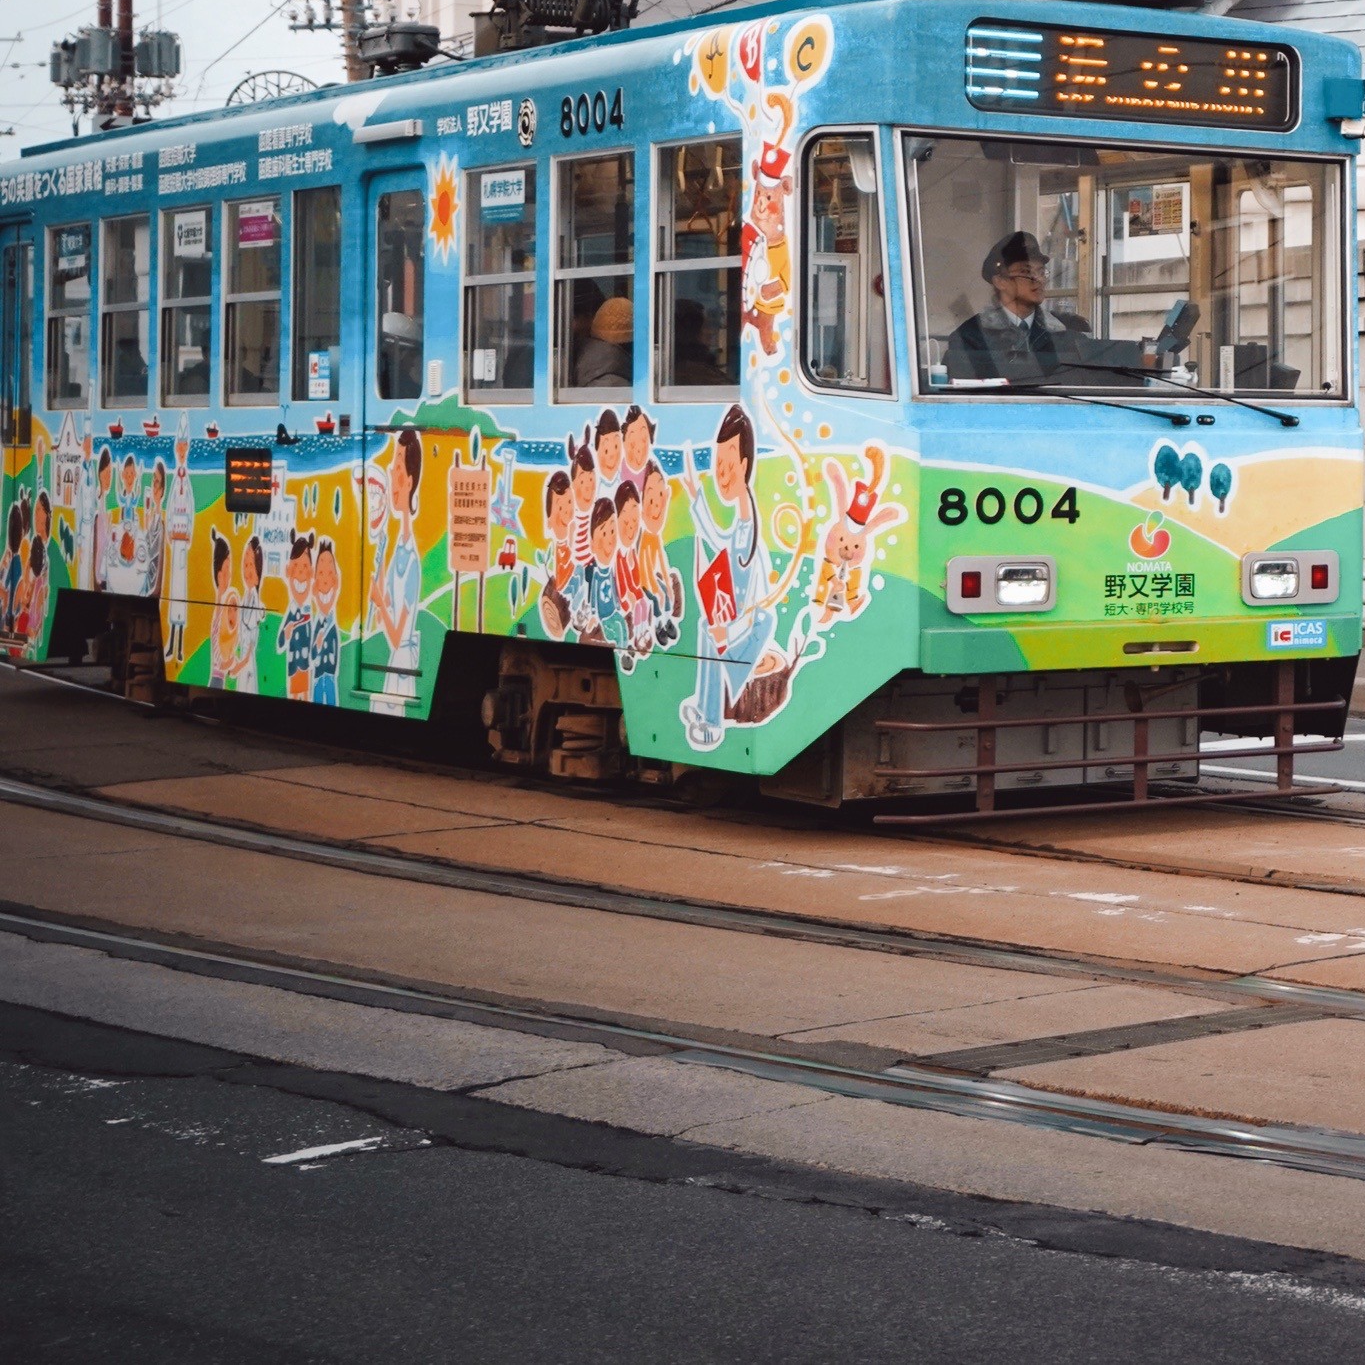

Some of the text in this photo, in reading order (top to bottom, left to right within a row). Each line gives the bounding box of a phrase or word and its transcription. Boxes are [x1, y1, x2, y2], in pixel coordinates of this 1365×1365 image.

[746, 23, 759, 69] B
[796, 36, 815, 72] C
[467, 99, 512, 136] 野又学園
[561, 87, 625, 138] 8004
[938, 487, 1080, 526] 8004
[1126, 561, 1173, 573] NOMATA
[1104, 574, 1196, 599] 野又学園
[1104, 601, 1195, 616] 短大・専門学校号
[1294, 622, 1323, 635] ICAS
[1294, 636, 1323, 645] nimoca
